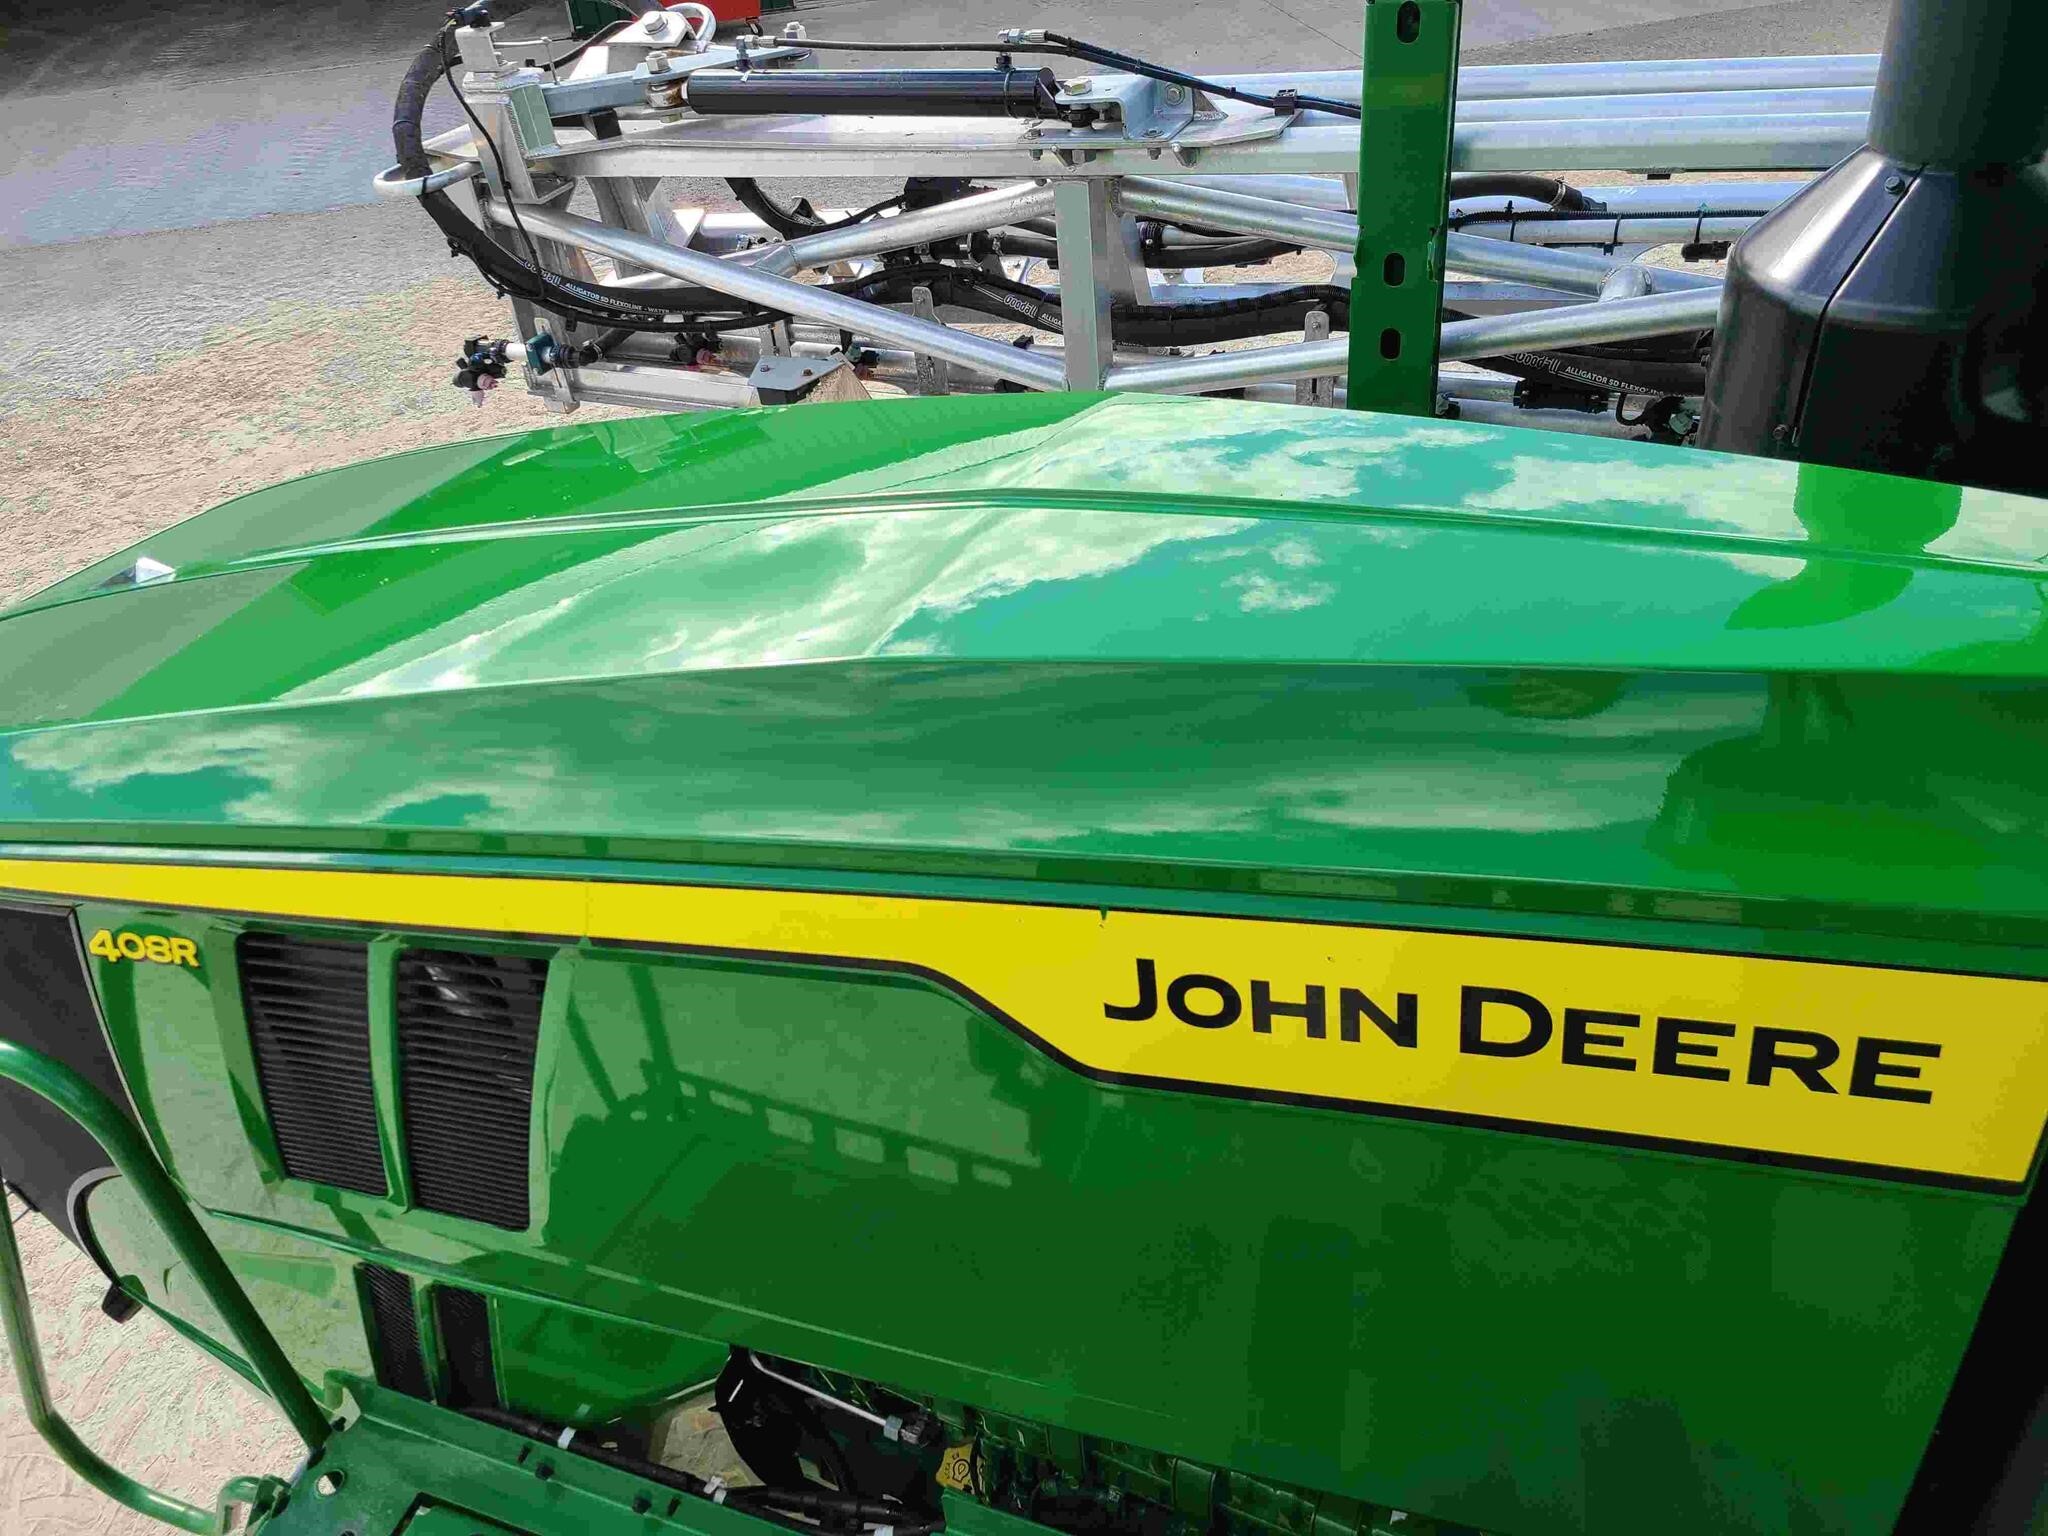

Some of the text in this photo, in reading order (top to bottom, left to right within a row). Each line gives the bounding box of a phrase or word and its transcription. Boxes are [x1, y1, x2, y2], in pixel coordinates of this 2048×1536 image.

[524, 261, 561, 286] Godall
[565, 282, 600, 301] ALLIGATOR
[1003, 293, 1063, 327] Goodall ALLIGA
[1565, 366, 1608, 384] ALLIGATOR
[88, 929, 200, 967] 408R
[1103, 958, 1943, 1104] JOHN DEERE
